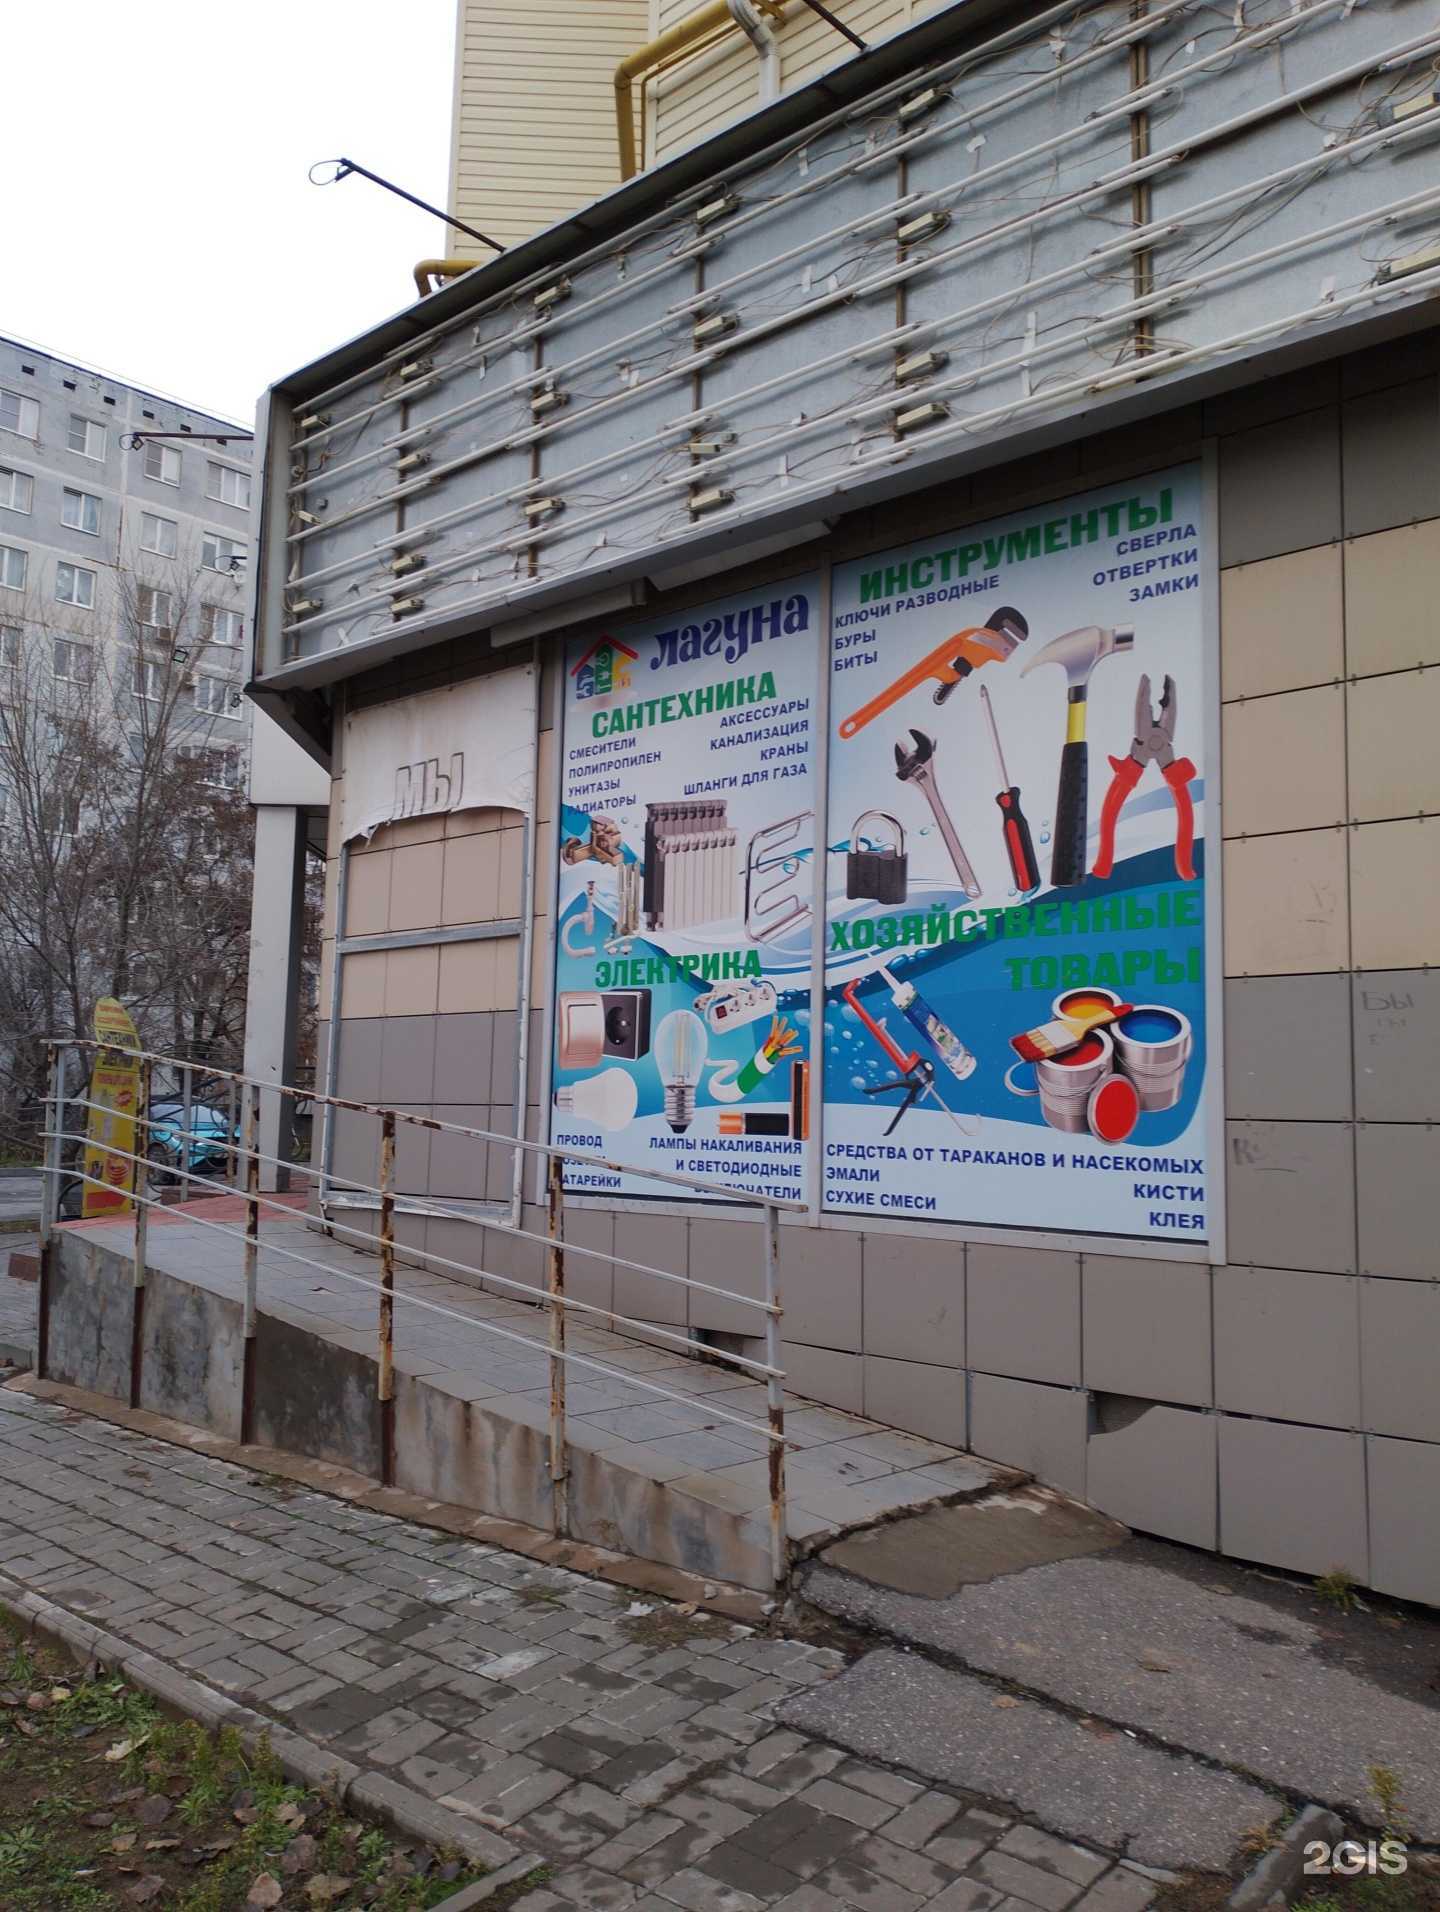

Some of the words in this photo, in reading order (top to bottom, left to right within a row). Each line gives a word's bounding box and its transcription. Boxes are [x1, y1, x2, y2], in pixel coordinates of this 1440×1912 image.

[860, 487, 1173, 604] ИНСТРУМЕНТЫ
[1116, 524, 1197, 557] СВЕРЛА
[1093, 549, 1198, 586] ОТВЕРТКИ
[835, 603, 891, 628] КЛЮЧИ
[896, 574, 1000, 613] РАЗВОДНЫЕ
[1129, 574, 1199, 602] ЗАМКИ
[834, 629, 876, 650] БУРЫ
[834, 651, 878, 672] БИТЫ
[592, 671, 776, 738] САНТЕХНИКА
[720, 698, 809, 728] АКСЕССУАРЫ
[569, 737, 636, 760] СМЕСИТЕЛИ
[710, 720, 809, 751] КАНАЛИЗАЦИЯ
[569, 751, 662, 779] ПОЛИПРОПИЛЕН
[760, 741, 808, 761] КРАНЫ
[568, 778, 621, 797] УНИТАЗЫ
[684, 776, 738, 795] ШЛАНГИ
[741, 770, 768, 786] ДЛЯ
[773, 763, 808, 780] ГАЗА
[831, 888, 1202, 951] ХОЗЯЙСТВЕННЫЕ
[595, 950, 762, 988] ЭЛЕКТРИКА
[1004, 946, 1200, 992] ТОВАРЫ
[557, 1135, 602, 1148] ПРОВОД
[650, 1137, 696, 1150] ЛАМПЫ
[700, 1139, 802, 1154] НАКАЛИВАНИЯ
[676, 1160, 684, 1170] И
[688, 1160, 802, 1177] СВЕТОДИОДНЫЕ
[826, 1144, 906, 1161] СРЕДСТВА
[912, 1147, 934, 1161] ОТ
[940, 1149, 1046, 1168] ТАРАКАНОВ
[1052, 1154, 1064, 1167] И
[1072, 1155, 1204, 1174] НАСЕКОМЫХ
[561, 1173, 621, 1188] АТАРЕЙКИ
[826, 1168, 880, 1182] ЭМАЛИ
[826, 1190, 875, 1206] СУХИЕ
[880, 1193, 936, 1210] СМЕСИ
[1133, 1184, 1204, 1201] КИСТИ
[1149, 1212, 1204, 1230] КЛЕЯ
